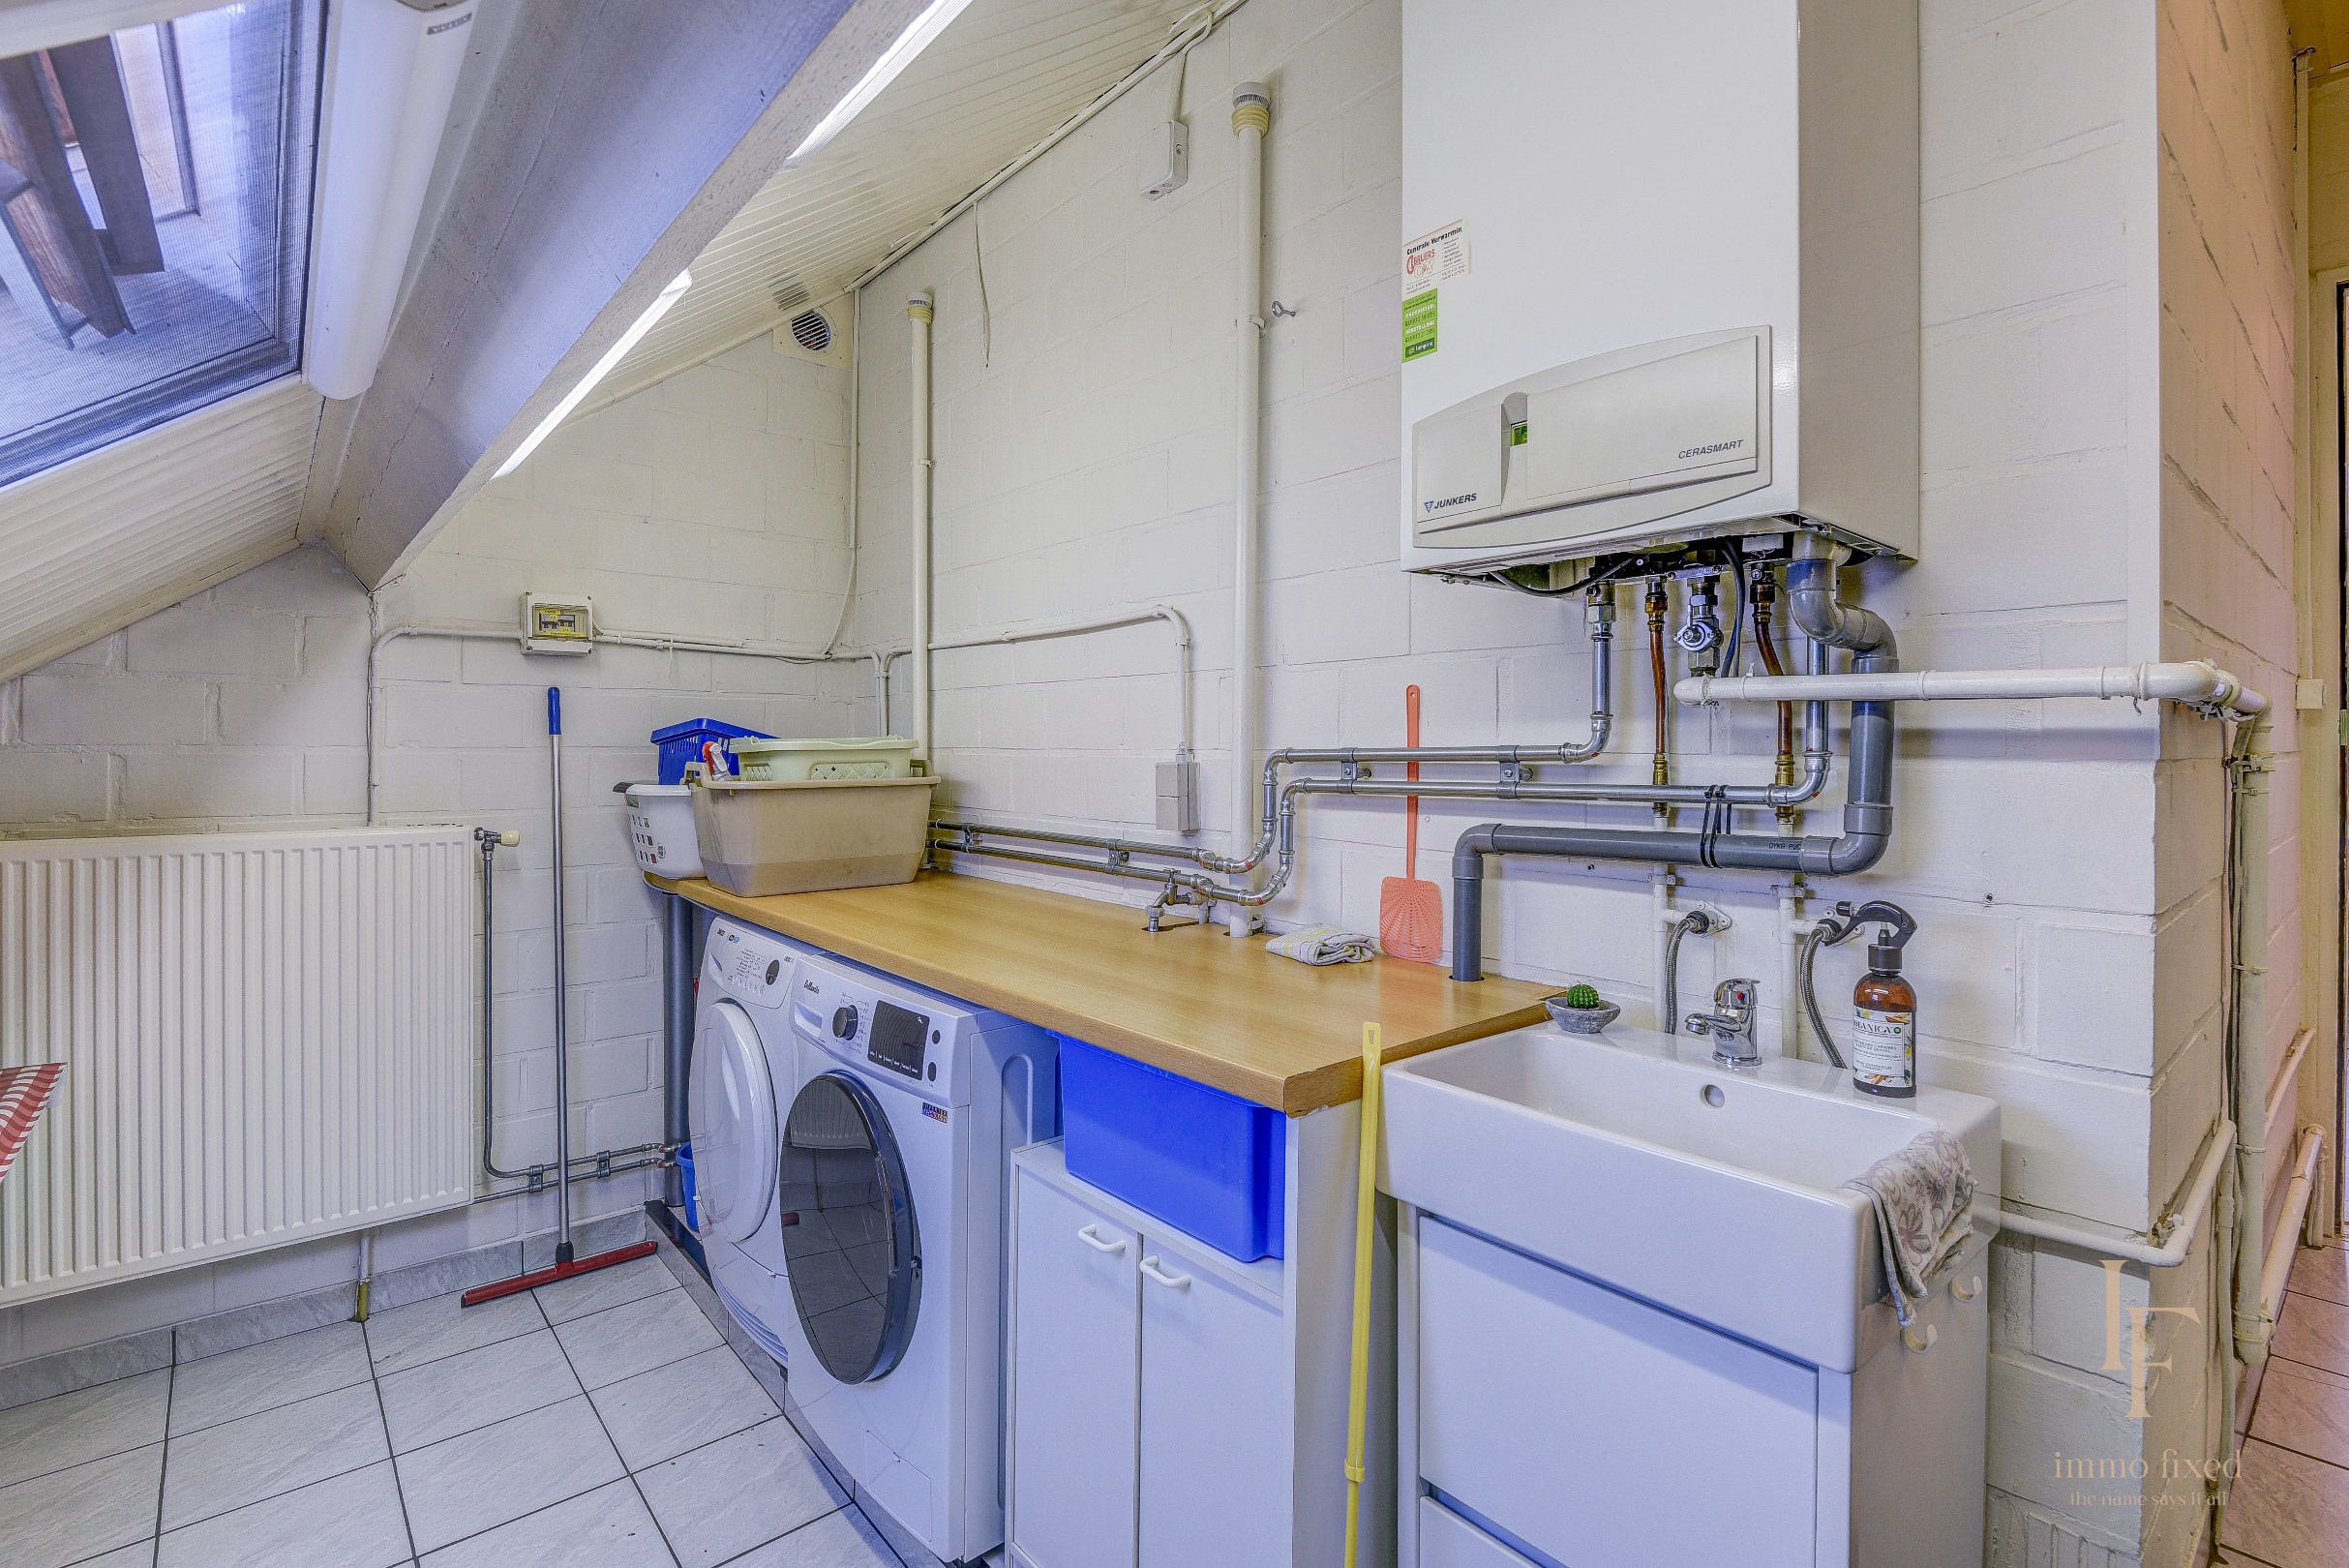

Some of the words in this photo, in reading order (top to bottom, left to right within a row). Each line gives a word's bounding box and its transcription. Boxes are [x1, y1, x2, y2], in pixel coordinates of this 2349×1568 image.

[1406, 240, 1430, 256] Centrale
[1678, 439, 1744, 460] CERASMART
[1433, 493, 1477, 509] JUNKERS
